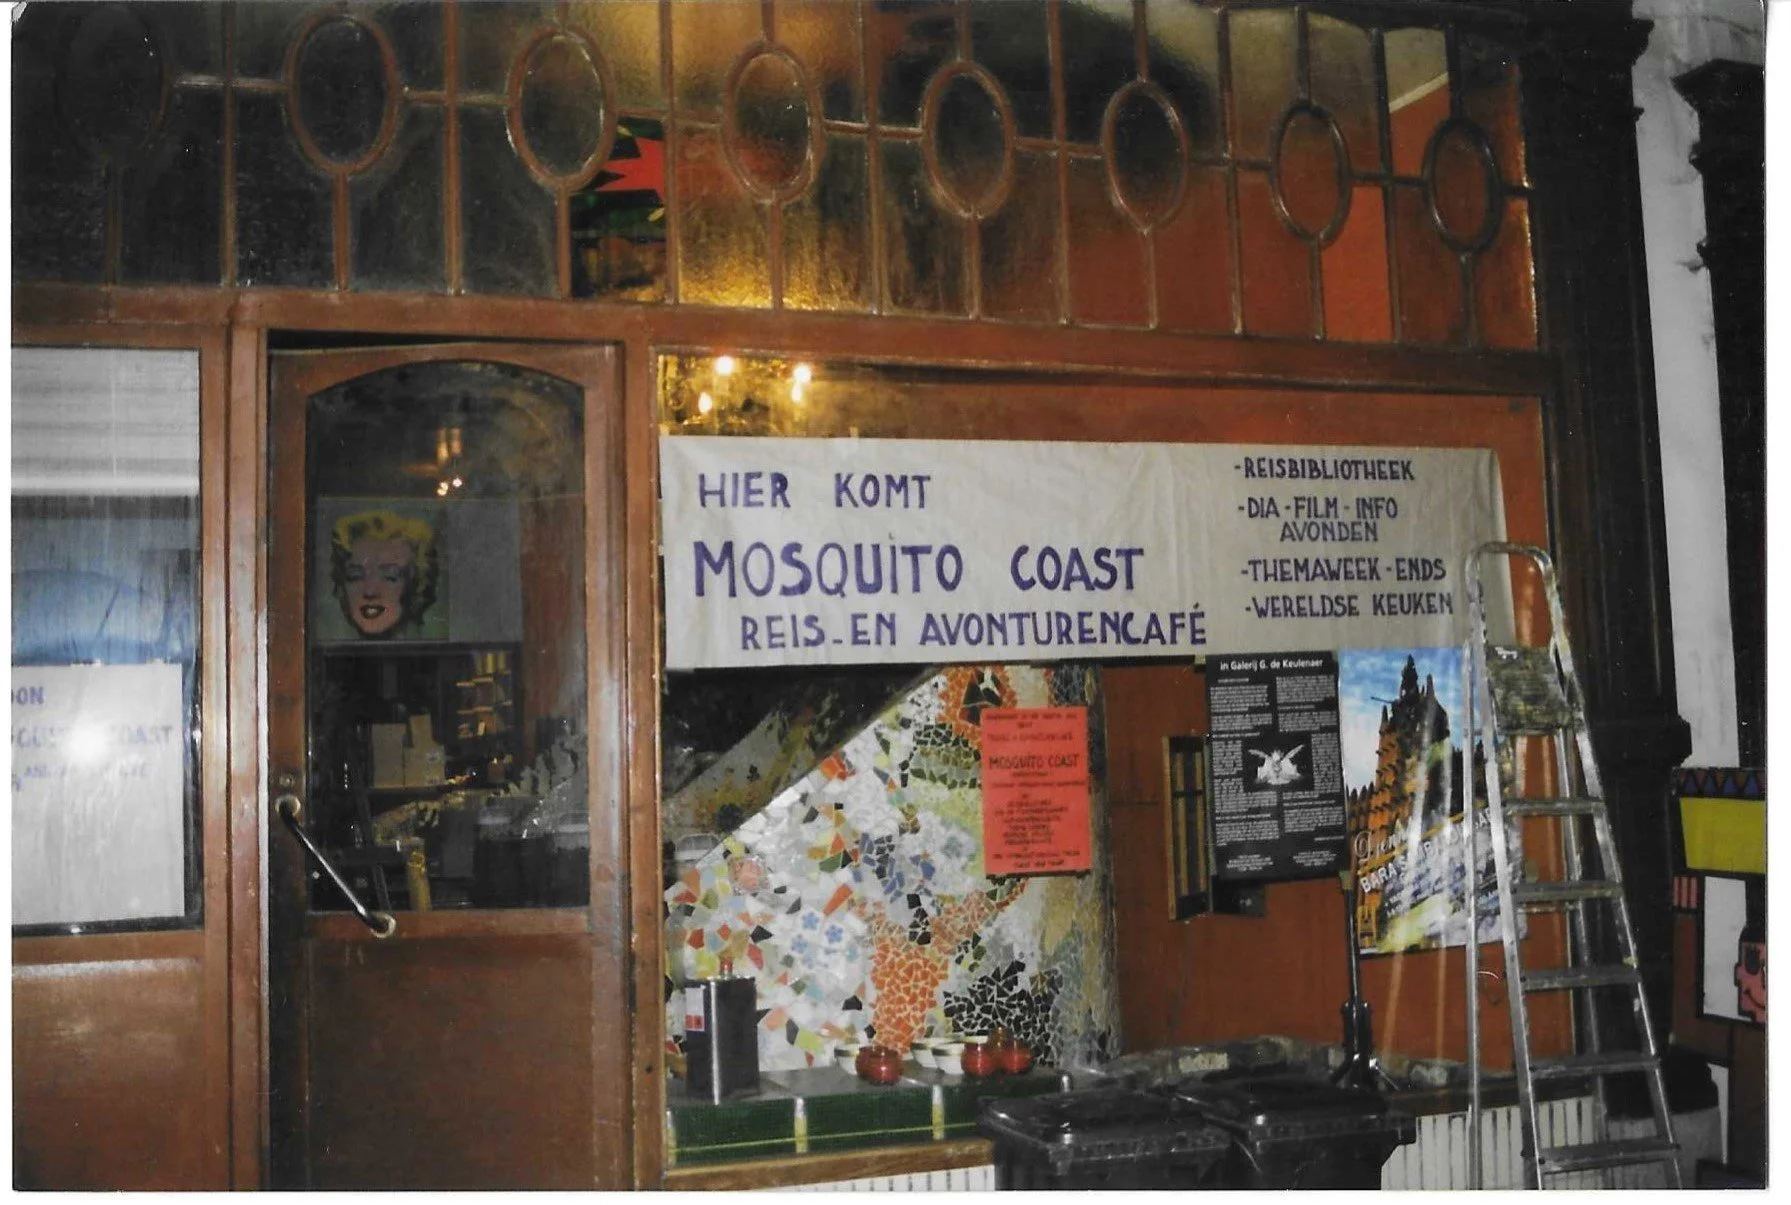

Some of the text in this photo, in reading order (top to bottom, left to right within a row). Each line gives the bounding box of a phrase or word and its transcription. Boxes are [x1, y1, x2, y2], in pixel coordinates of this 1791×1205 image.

[698, 471, 932, 509] HIER KOMT
[1279, 520, 1379, 543] AVONDEN
[1010, 545, 1146, 593] COAST
[1372, 592, 1454, 616] KEUKEN
[918, 601, 1209, 650] AVONTURENCAFÉ
[1220, 660, 1229, 671] in
[1230, 659, 1258, 672] Galerij
[1270, 660, 1281, 669] de
